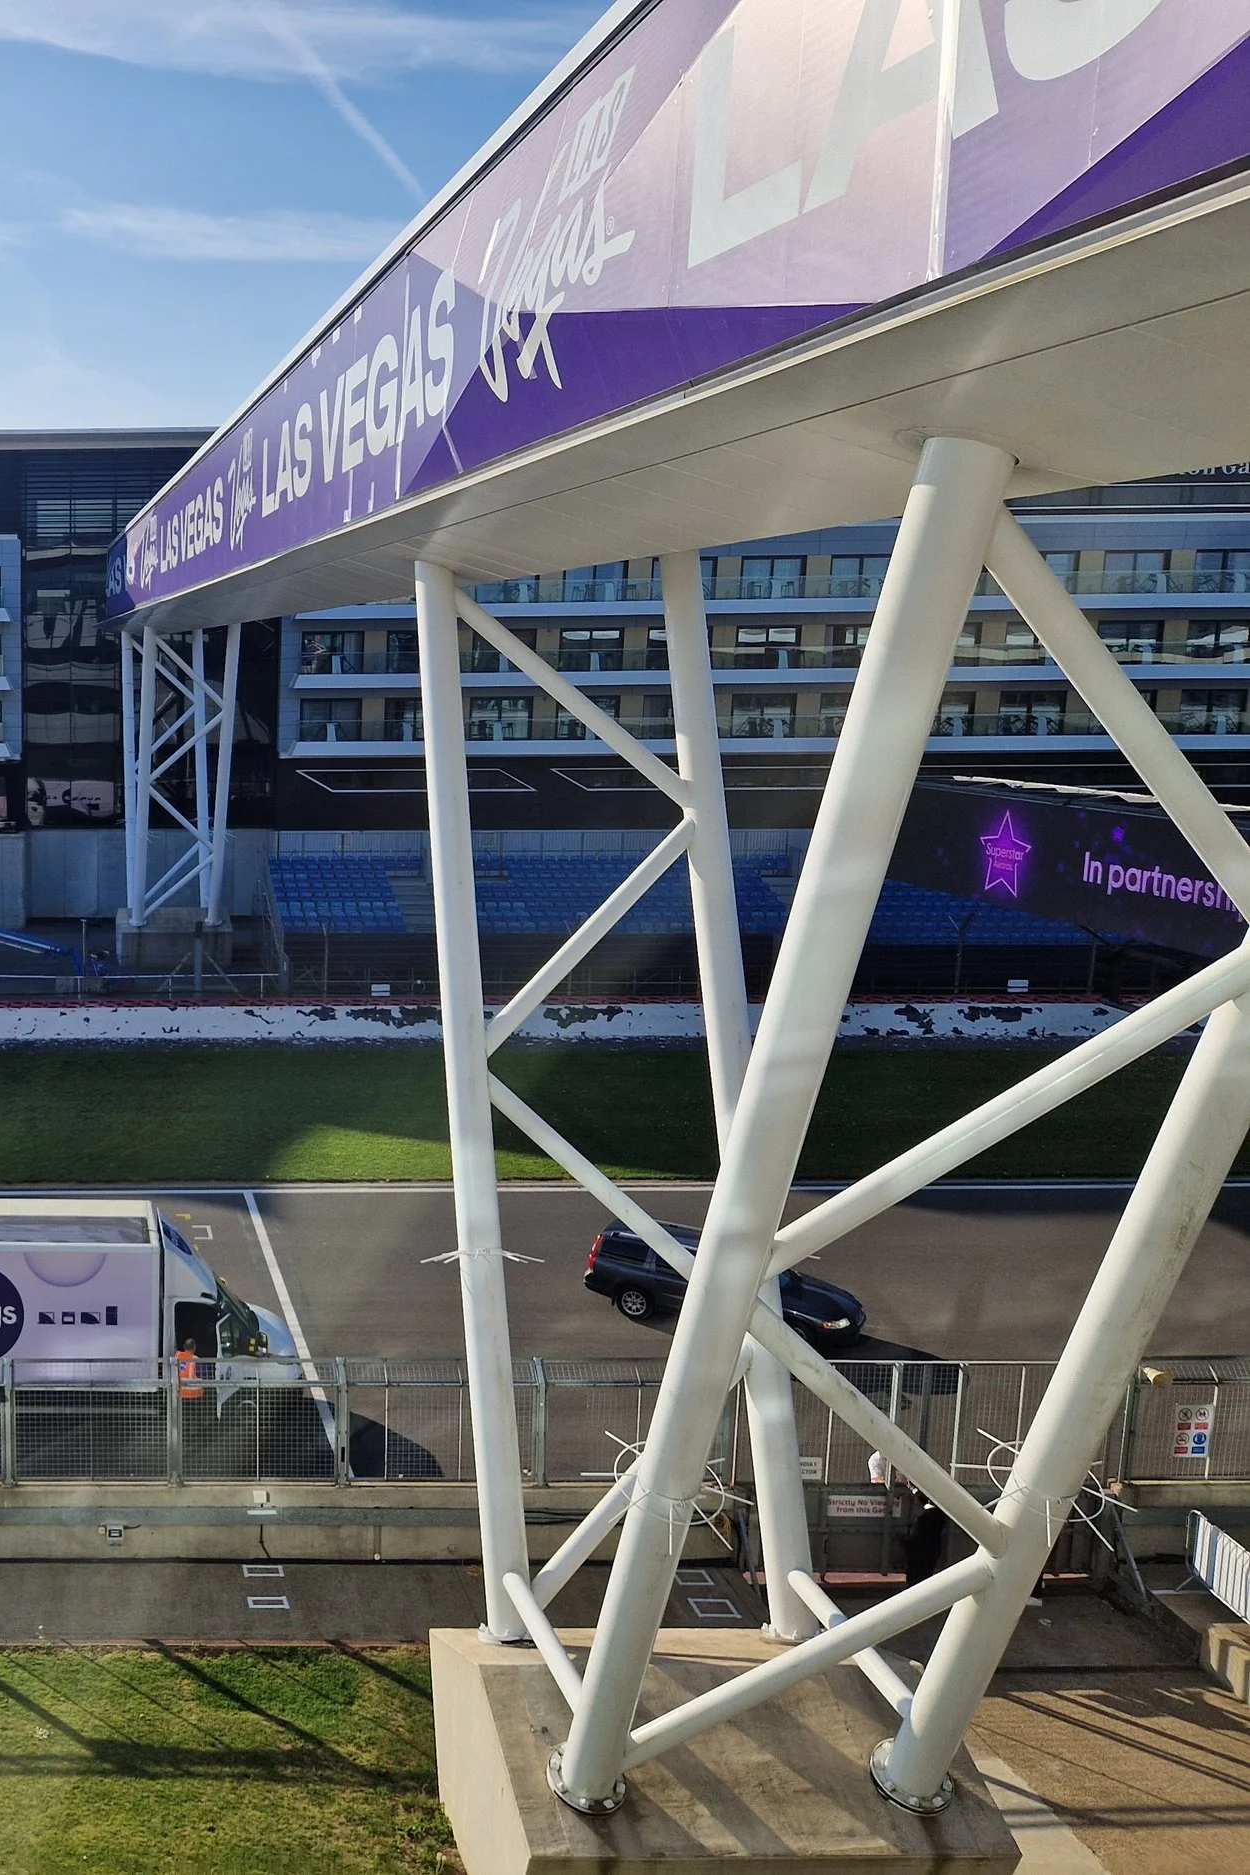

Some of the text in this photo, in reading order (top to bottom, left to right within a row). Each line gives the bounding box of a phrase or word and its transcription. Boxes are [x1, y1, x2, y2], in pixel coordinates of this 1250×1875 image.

[687, 0, 1162, 269] LA
[262, 268, 456, 518] LAS VEGAS
[160, 513, 179, 574] LAS
[180, 475, 224, 562] VEGAS
[985, 842, 1025, 861] Superstar
[1082, 851, 1103, 885] In
[827, 1499, 856, 1507] Strictly
